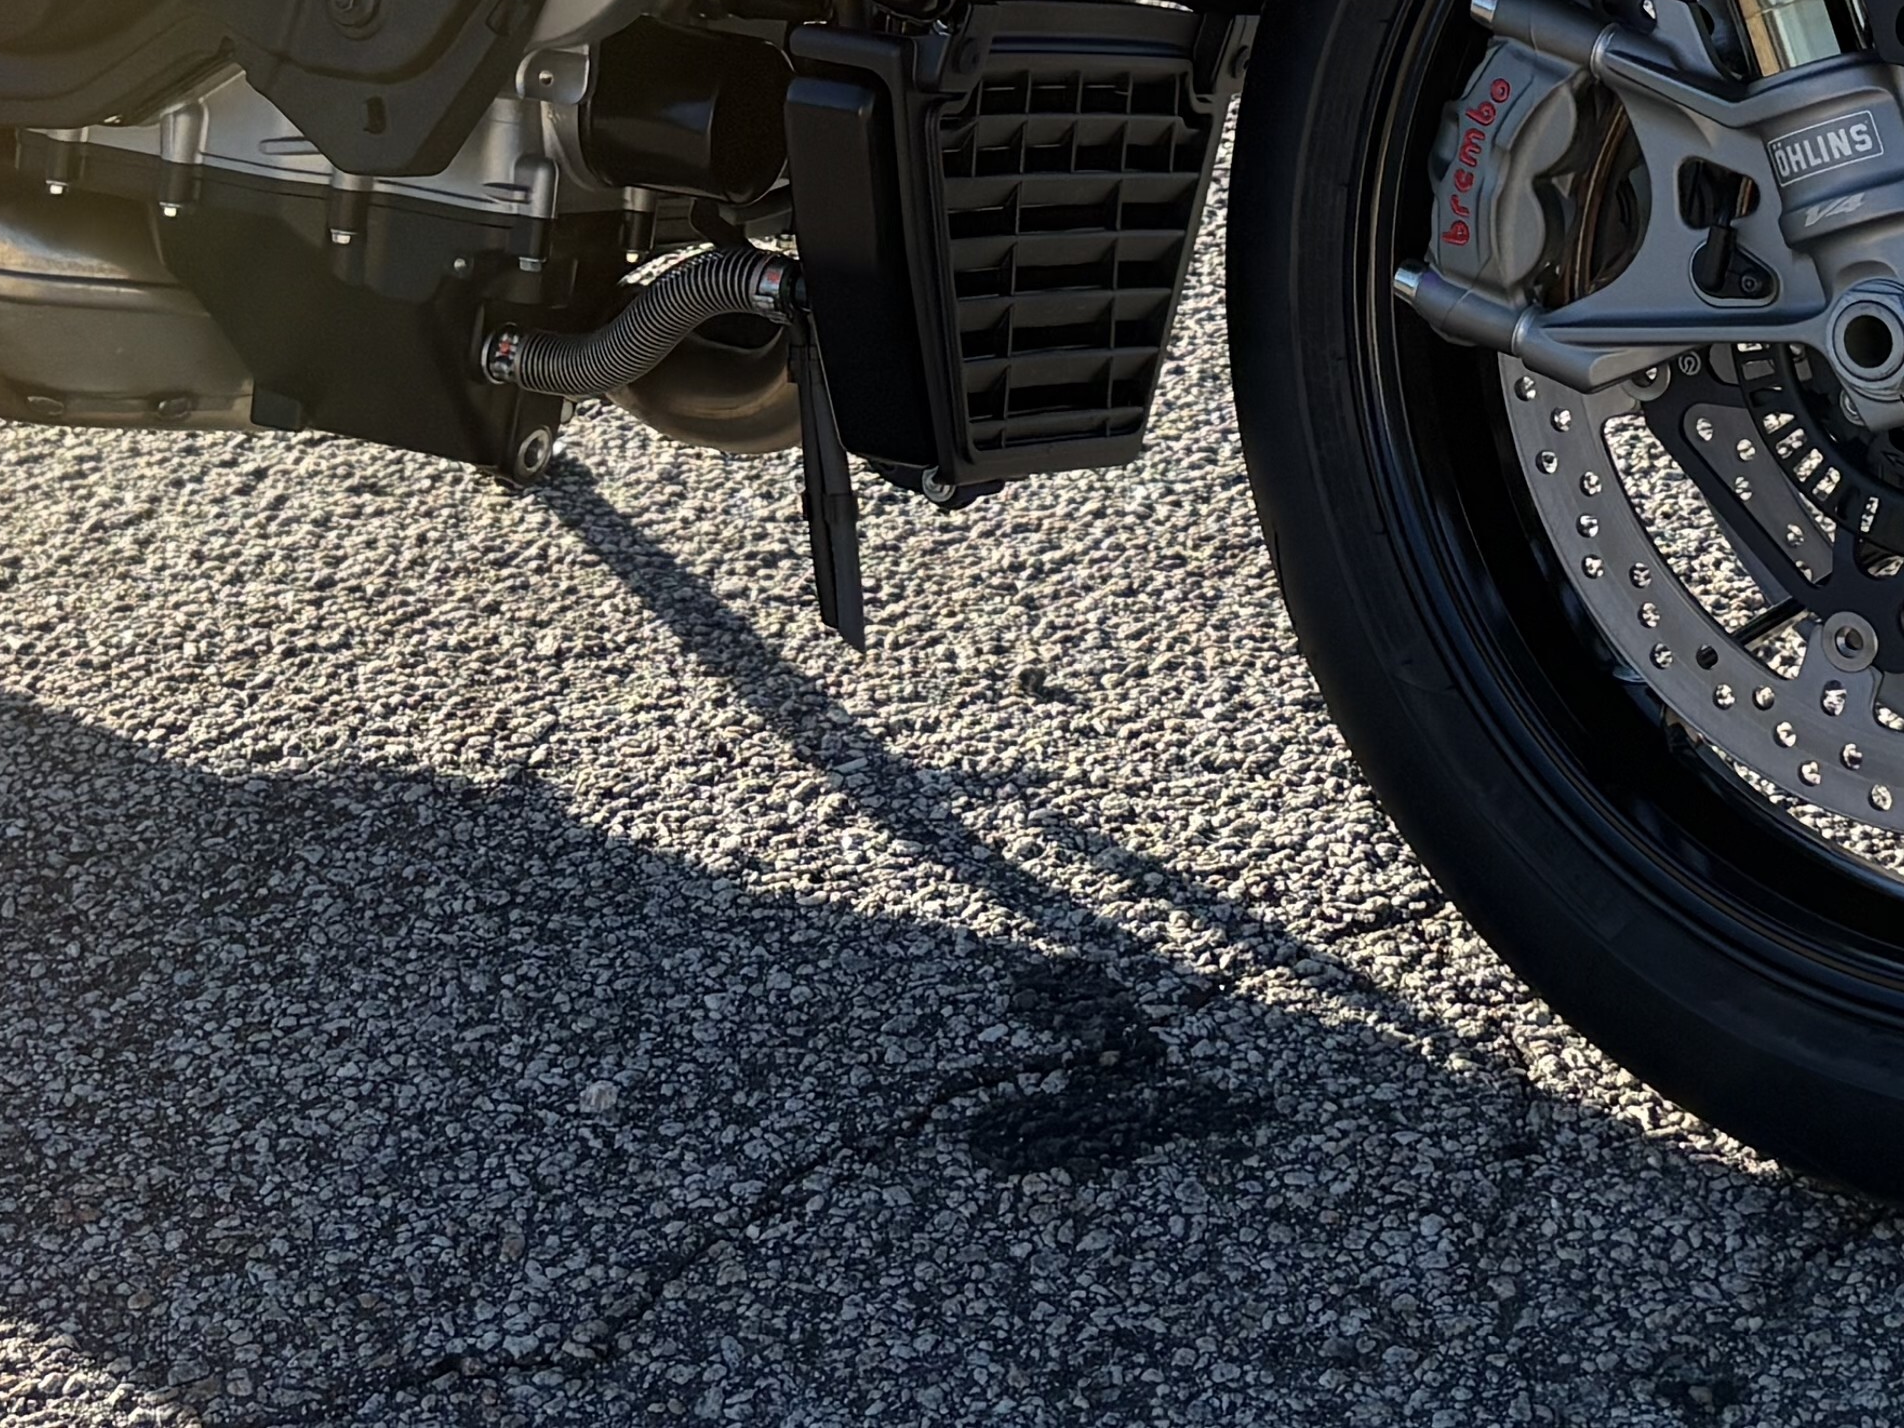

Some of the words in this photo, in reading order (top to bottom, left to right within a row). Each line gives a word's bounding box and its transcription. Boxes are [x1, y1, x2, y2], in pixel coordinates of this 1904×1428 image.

[1440, 77, 1511, 246] brembo
[1772, 122, 1873, 178] ÖHLINS
[1804, 191, 1865, 227] V4
